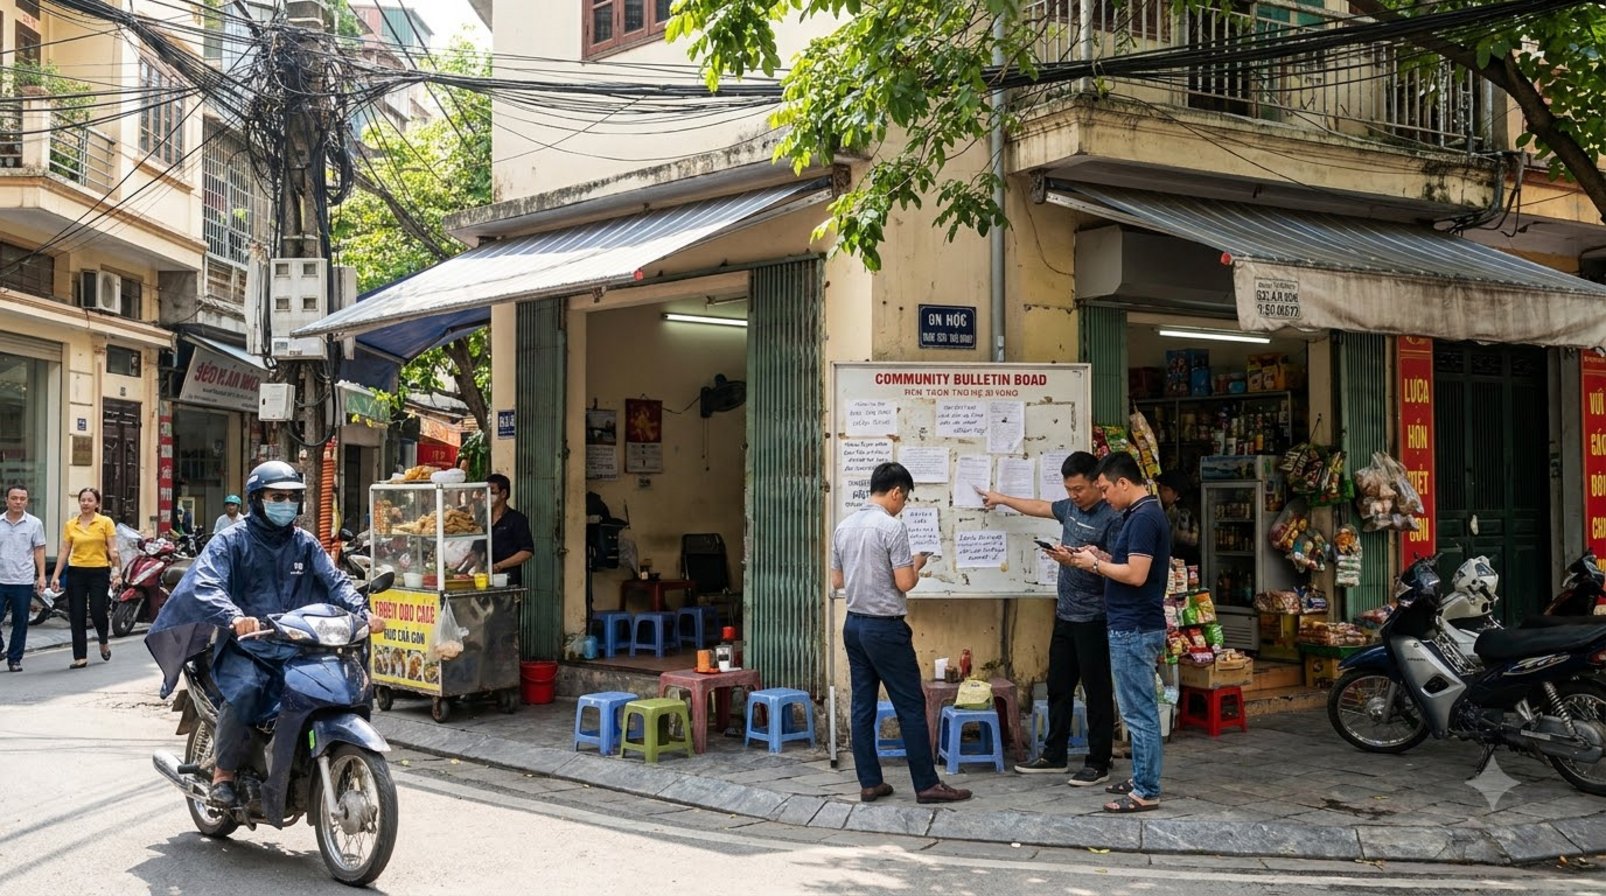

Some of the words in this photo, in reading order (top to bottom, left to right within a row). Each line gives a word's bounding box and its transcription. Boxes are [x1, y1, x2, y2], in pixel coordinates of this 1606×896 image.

[875, 373, 950, 386] COMMUNITY
[953, 373, 1011, 386] BULLETIN
[1014, 374, 1047, 386] BOAD
